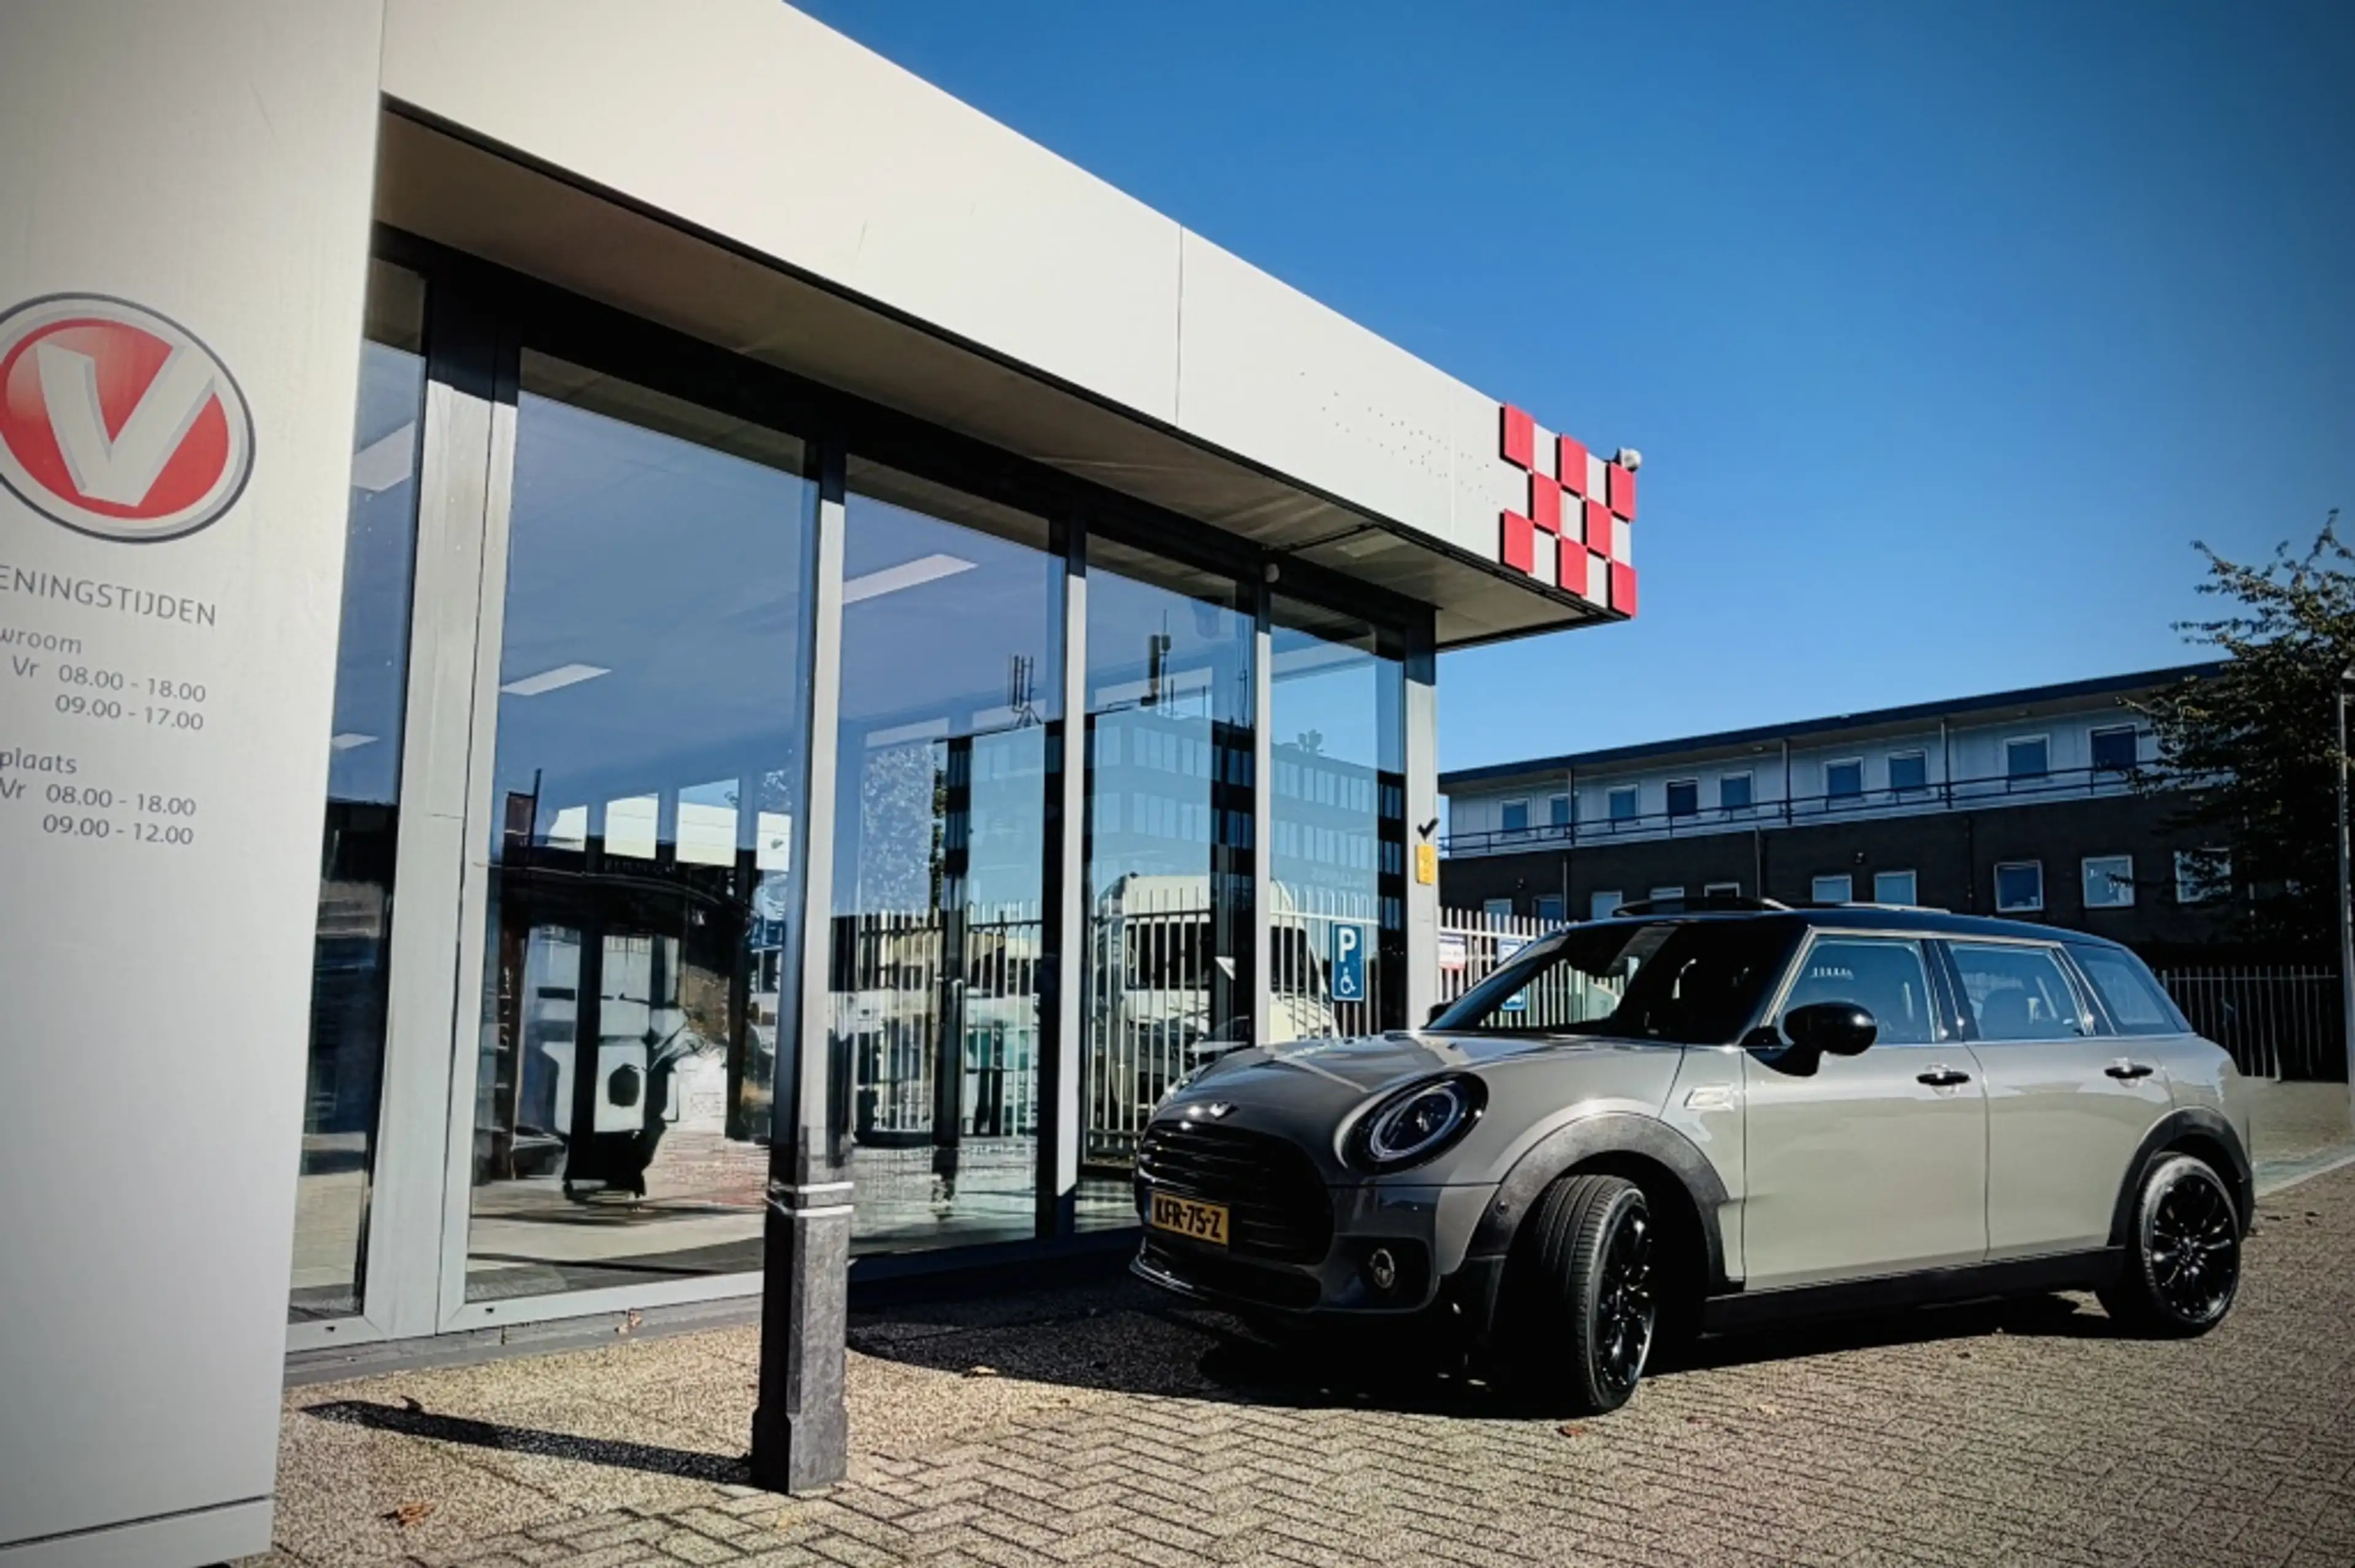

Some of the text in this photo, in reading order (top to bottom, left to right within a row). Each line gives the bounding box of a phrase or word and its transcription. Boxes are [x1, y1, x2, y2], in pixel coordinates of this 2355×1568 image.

[12, 656, 40, 677] Vr
[59, 664, 123, 690] 08.00
[149, 678, 206, 703] 18.00
[55, 694, 121, 719] 09.00
[145, 707, 204, 730] 17.00
[0, 748, 78, 774] plaats
[0, 777, 26, 800] Vr
[46, 784, 112, 809] 08.00
[137, 794, 196, 817] 18.00
[43, 814, 110, 838] 09.00
[133, 823, 194, 845] 12.00
[1338, 927, 1357, 962] P
